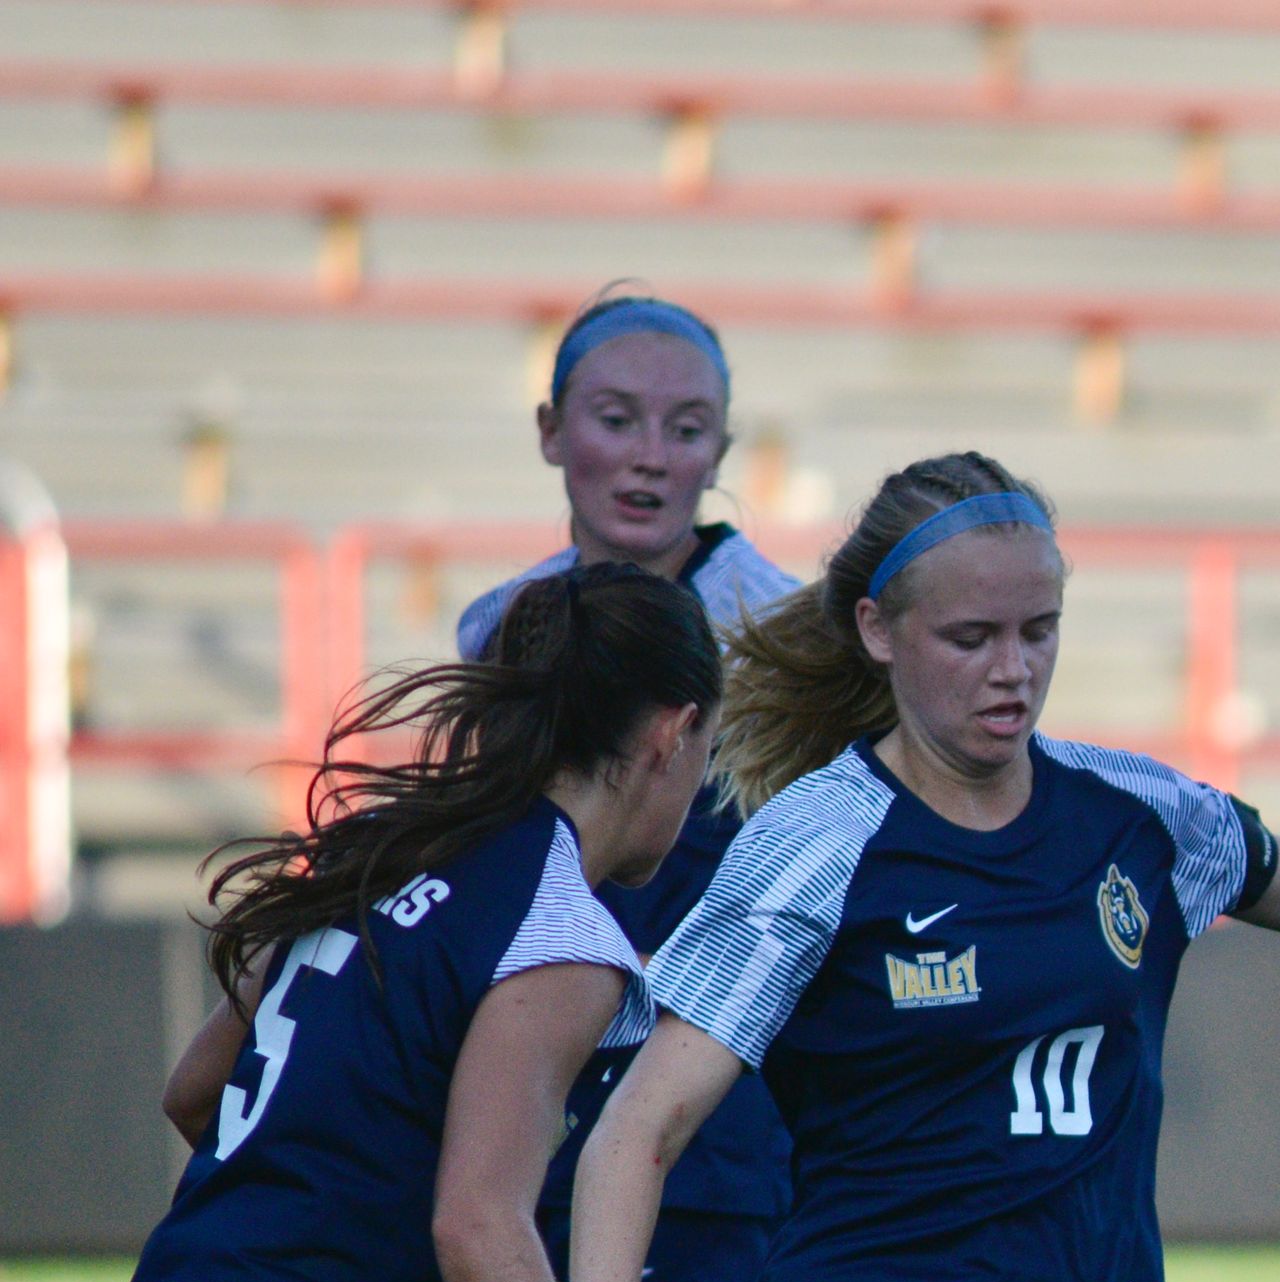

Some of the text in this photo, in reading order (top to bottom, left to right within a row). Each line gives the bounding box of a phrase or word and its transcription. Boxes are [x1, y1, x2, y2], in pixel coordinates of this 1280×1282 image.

[885, 944, 978, 1001] VALLEY
[214, 927, 359, 1161] 5
[1010, 1024, 1105, 1136] 10
